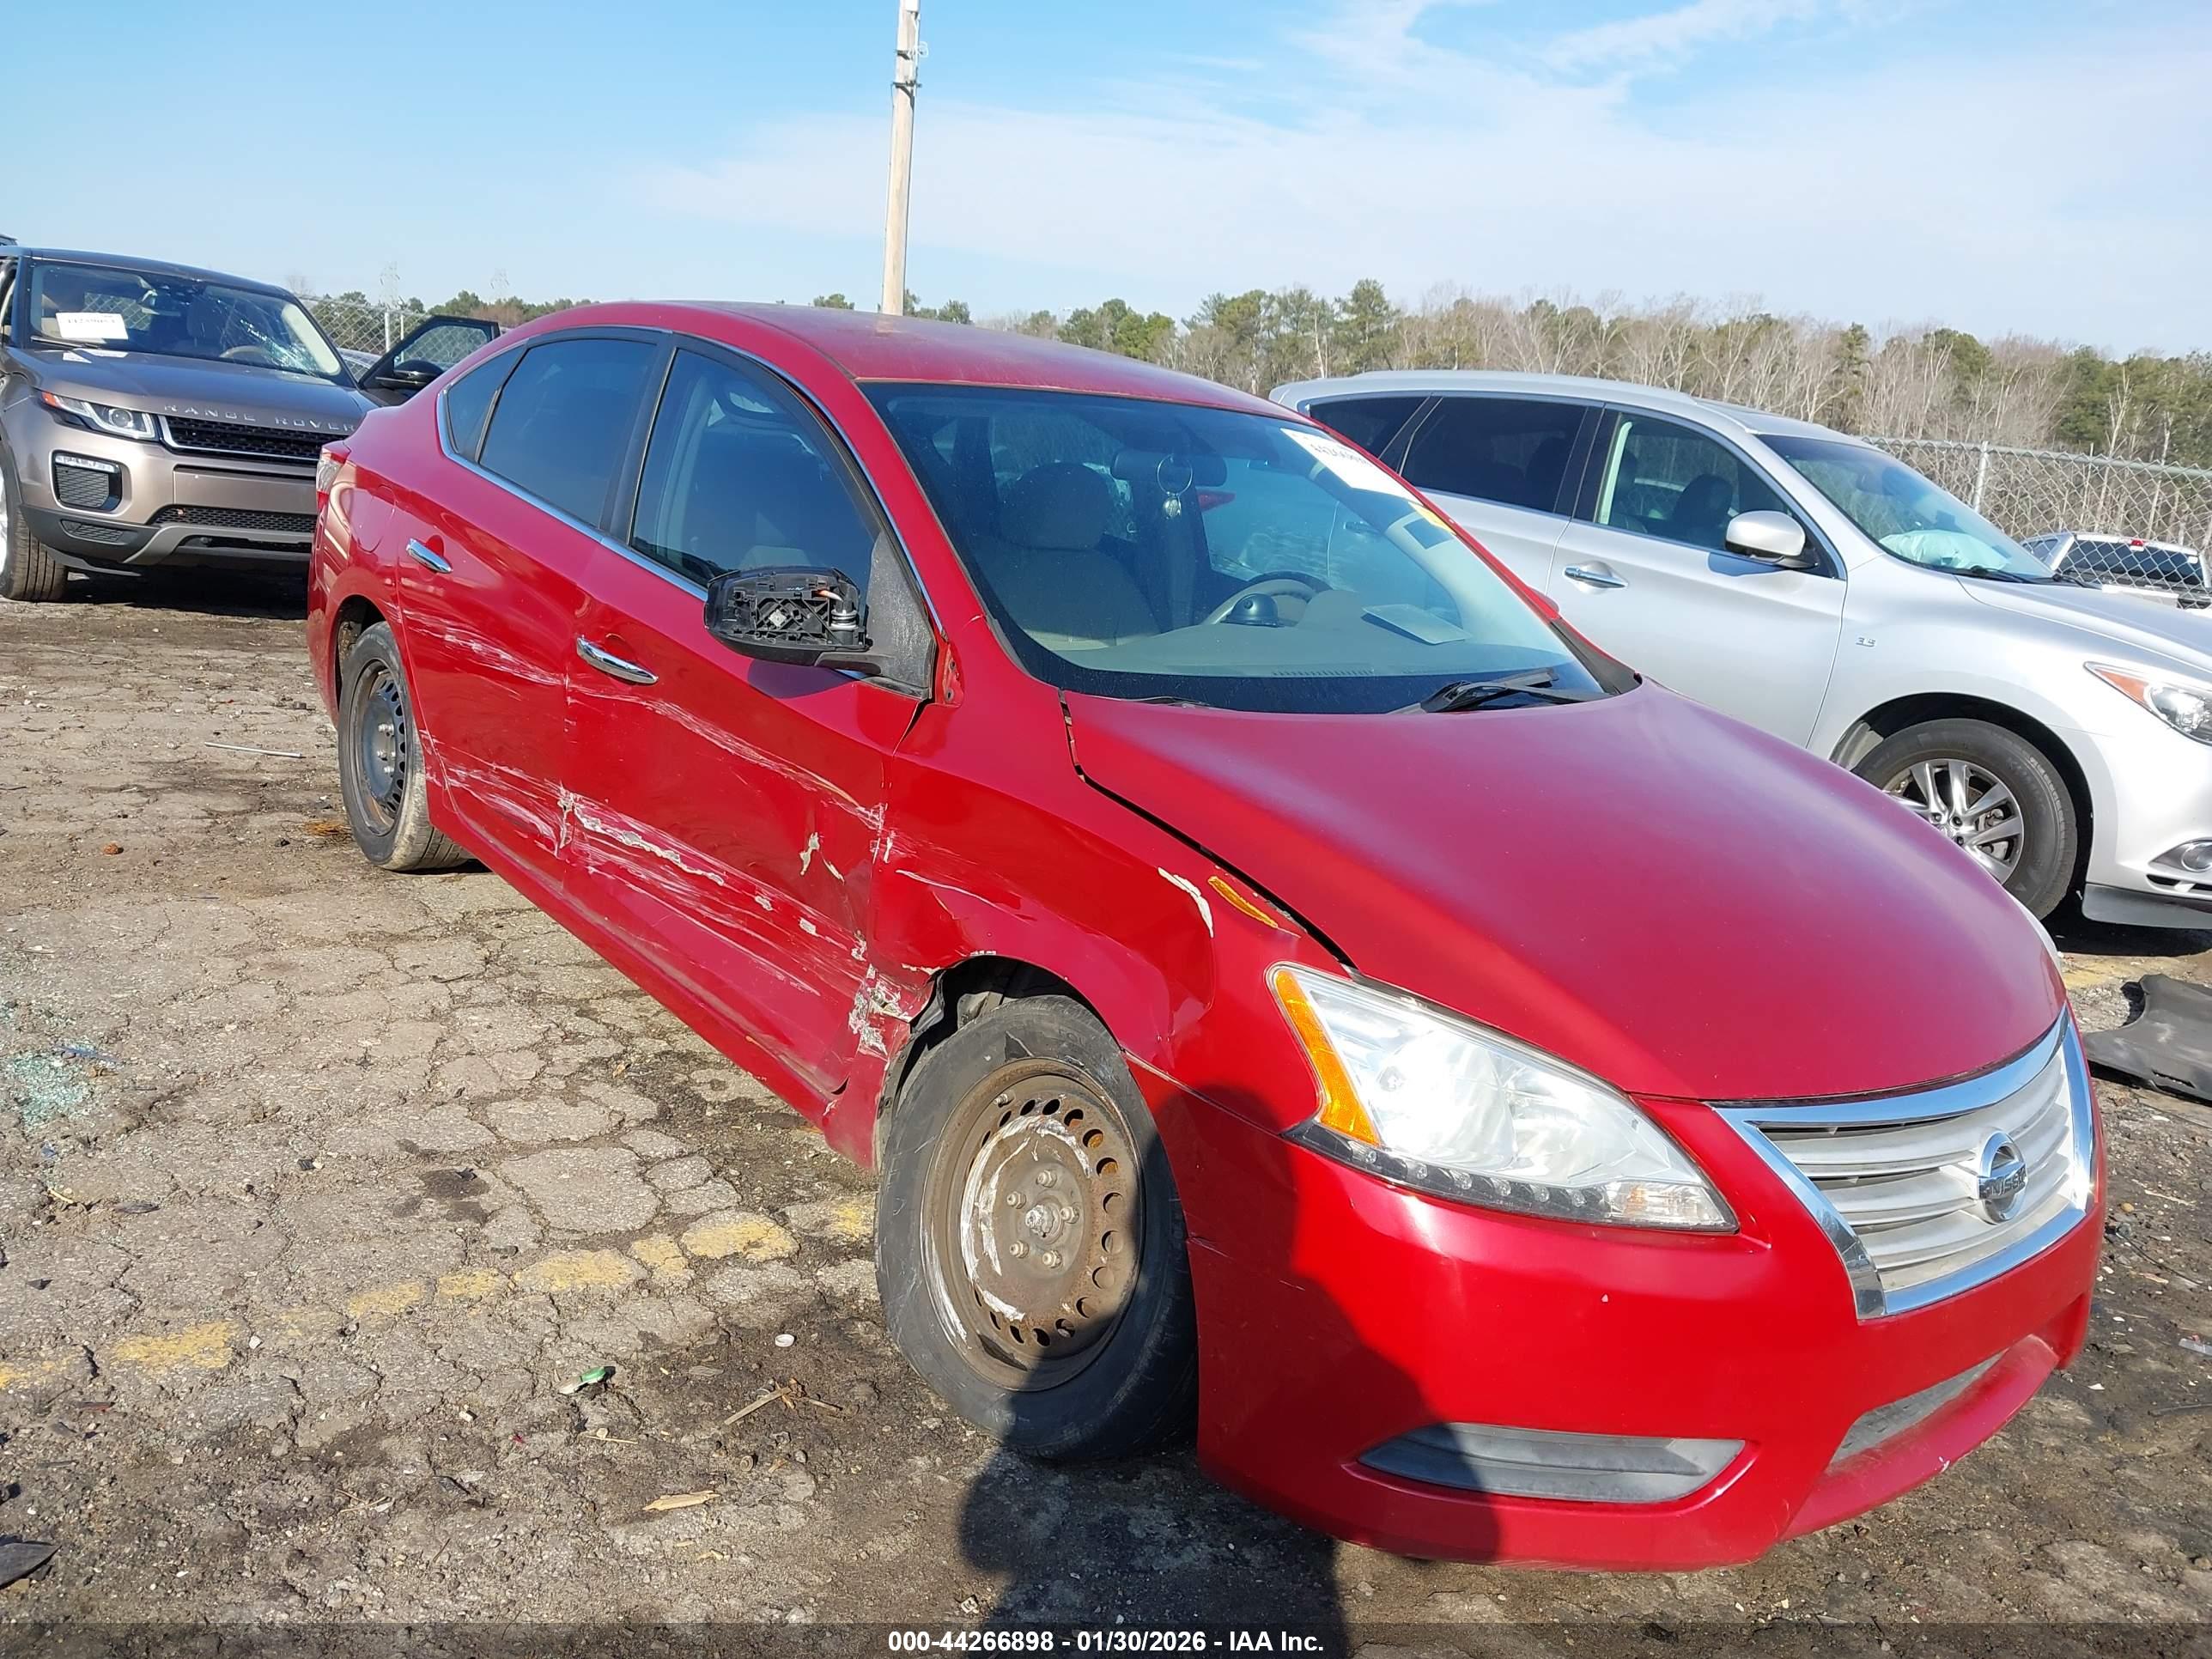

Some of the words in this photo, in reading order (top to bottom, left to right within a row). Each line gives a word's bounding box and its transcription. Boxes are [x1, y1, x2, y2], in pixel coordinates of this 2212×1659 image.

[164, 404, 257, 422] RANGE
[274, 416, 354, 432] ROVER
[1991, 1165, 2026, 1195] NISSA
